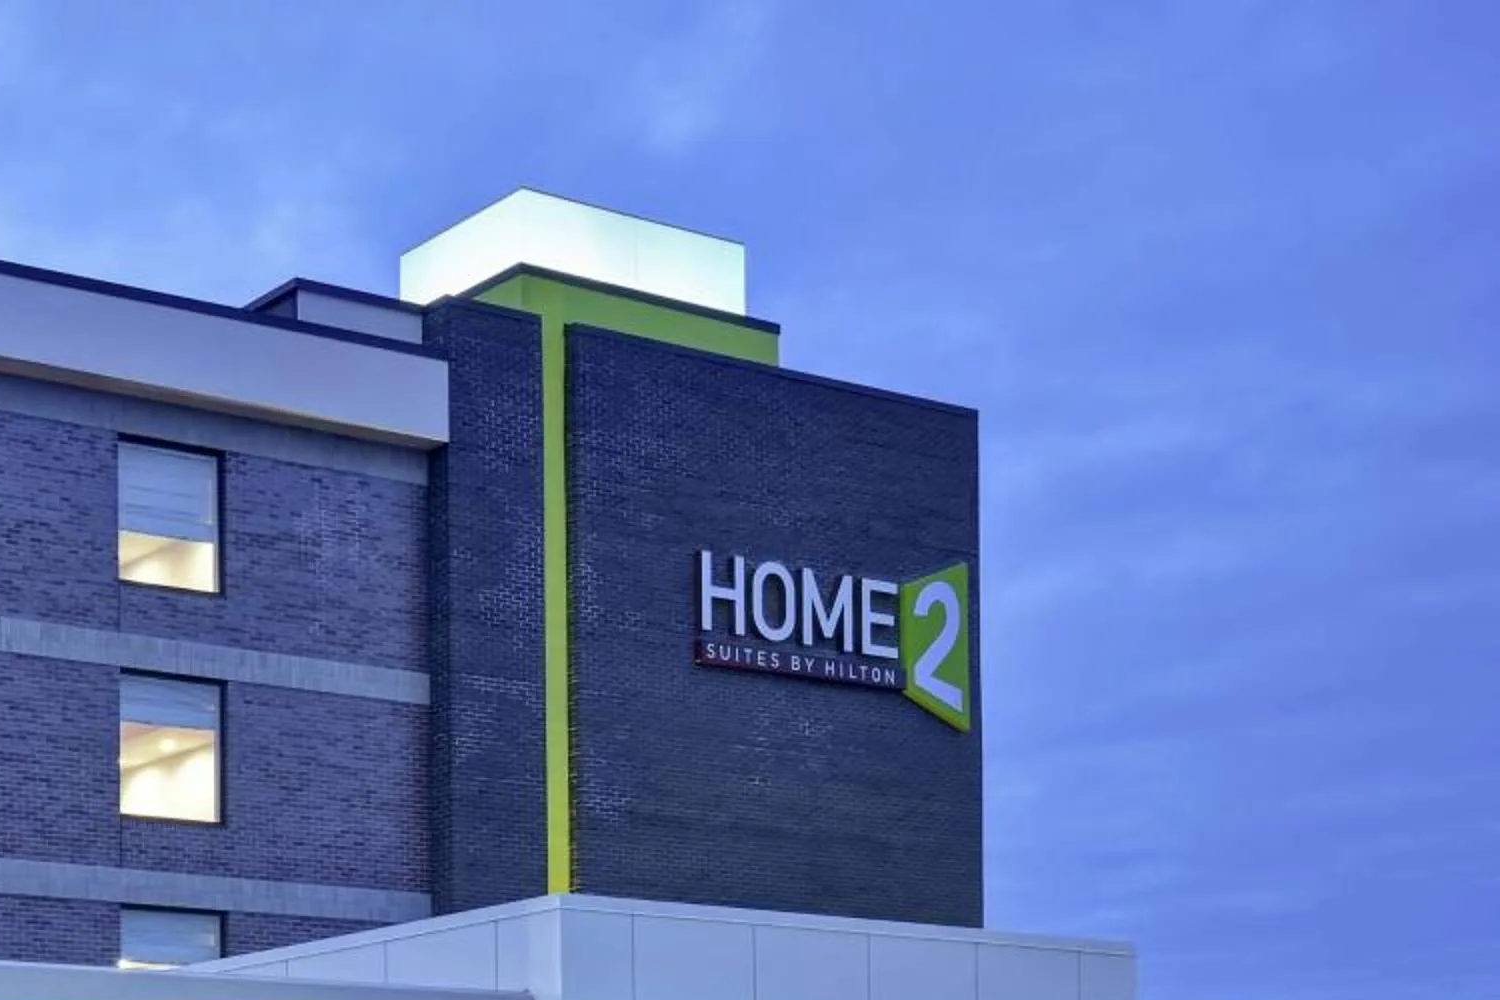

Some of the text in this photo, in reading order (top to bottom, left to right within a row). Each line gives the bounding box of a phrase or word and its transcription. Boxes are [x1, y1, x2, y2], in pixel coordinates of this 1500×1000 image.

[701, 550, 963, 713] HOME 2
[705, 642, 896, 686] SUITES BY HILTON
